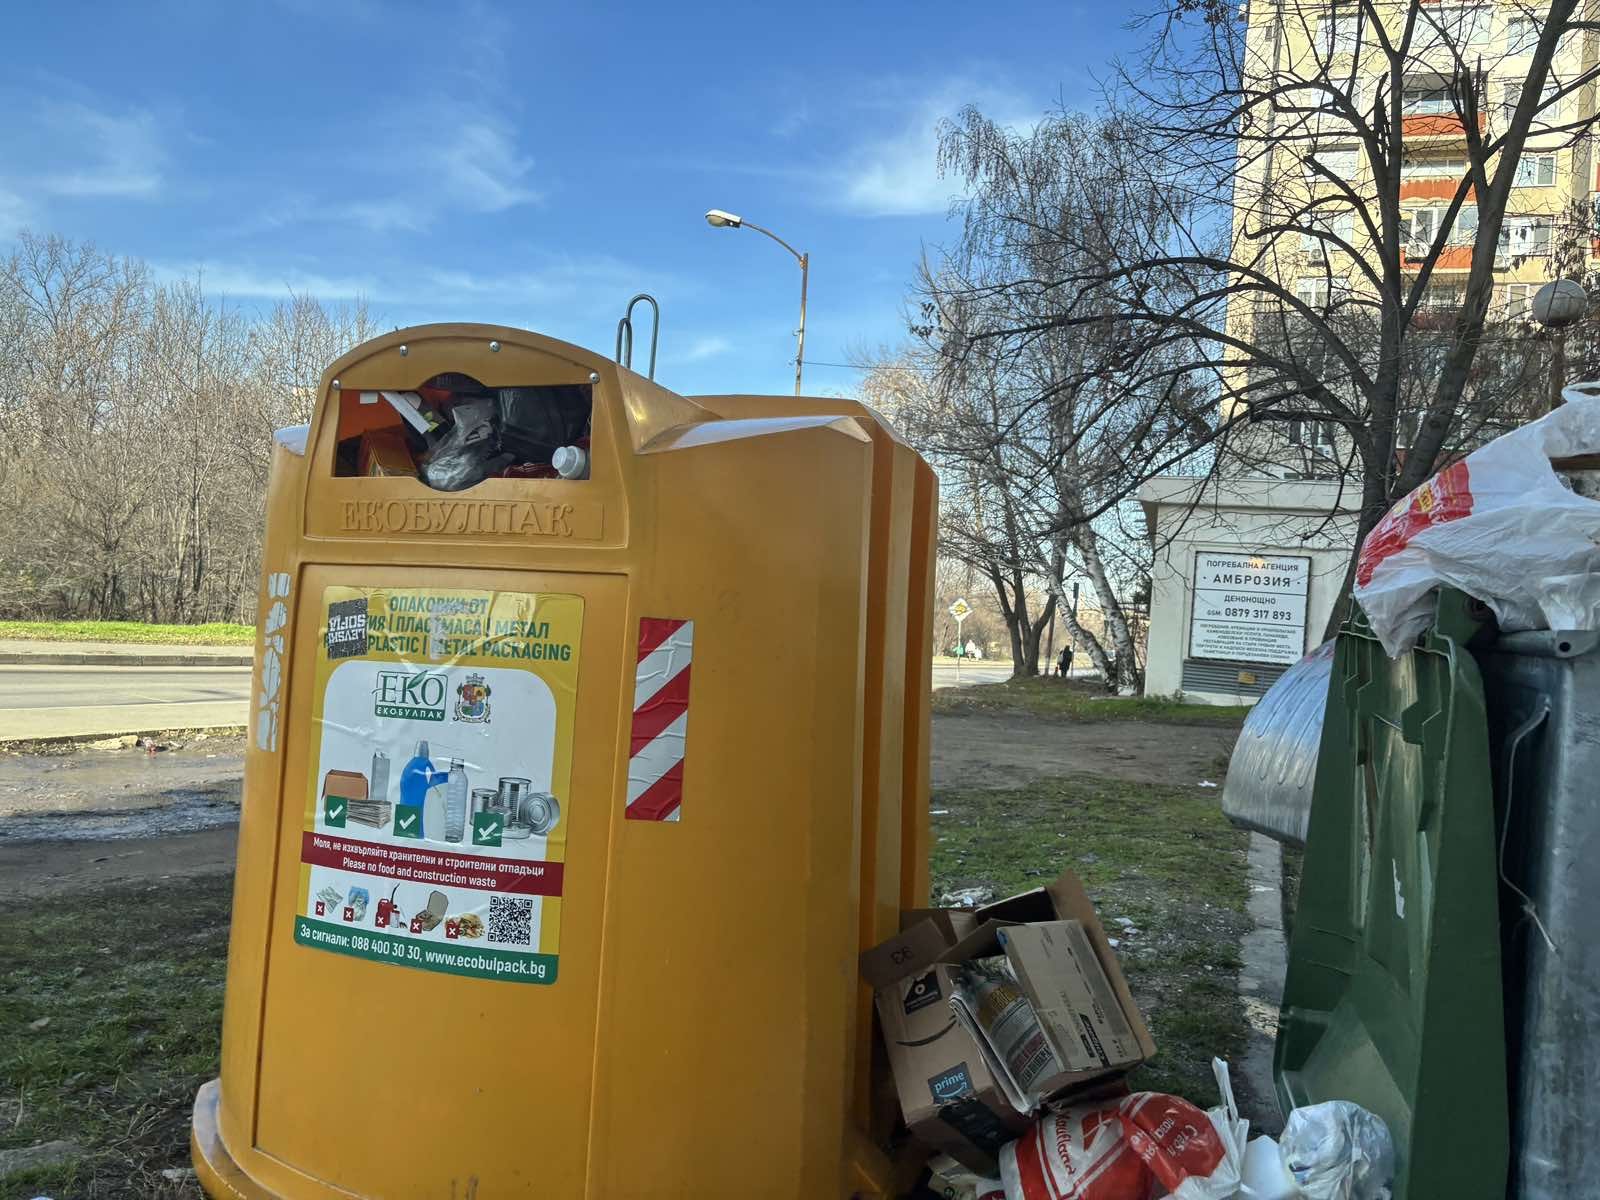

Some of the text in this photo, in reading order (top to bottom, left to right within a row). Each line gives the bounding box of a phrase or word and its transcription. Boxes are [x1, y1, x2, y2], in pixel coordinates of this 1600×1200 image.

[340, 500, 574, 537] ЕКОБУЛПАК
[1207, 559, 1299, 572] ПОГРЕБАЛНА АГЕНЦИЯ
[1213, 573, 1291, 588] АМБРОЗИЯ
[1224, 594, 1276, 605] ДЕНОНОЩНО
[1224, 607, 1250, 618] 0879
[1253, 609, 1269, 619] 317
[1272, 610, 1292, 620] 893
[495, 620, 550, 639] МЕТАЛ
[368, 635, 572, 662] PLASTIC ETAL PACKAGING
[376, 705, 443, 720] ЕКОБУЛПАК
[313, 836, 332, 851] Моля,
[333, 841, 342, 849] не
[342, 842, 388, 859] изхвърляйте
[389, 850, 436, 865] хранителни
[445, 857, 497, 872] строителни
[498, 864, 545, 877] отпадъци
[343, 857, 497, 888] Please no food and construction waste
[300, 923, 546, 979] За сигнали: 088 400 30 30, www.ecobulpack.bg
[934, 1072, 965, 1094] prime
[1055, 1109, 1077, 1175] Kaufland
